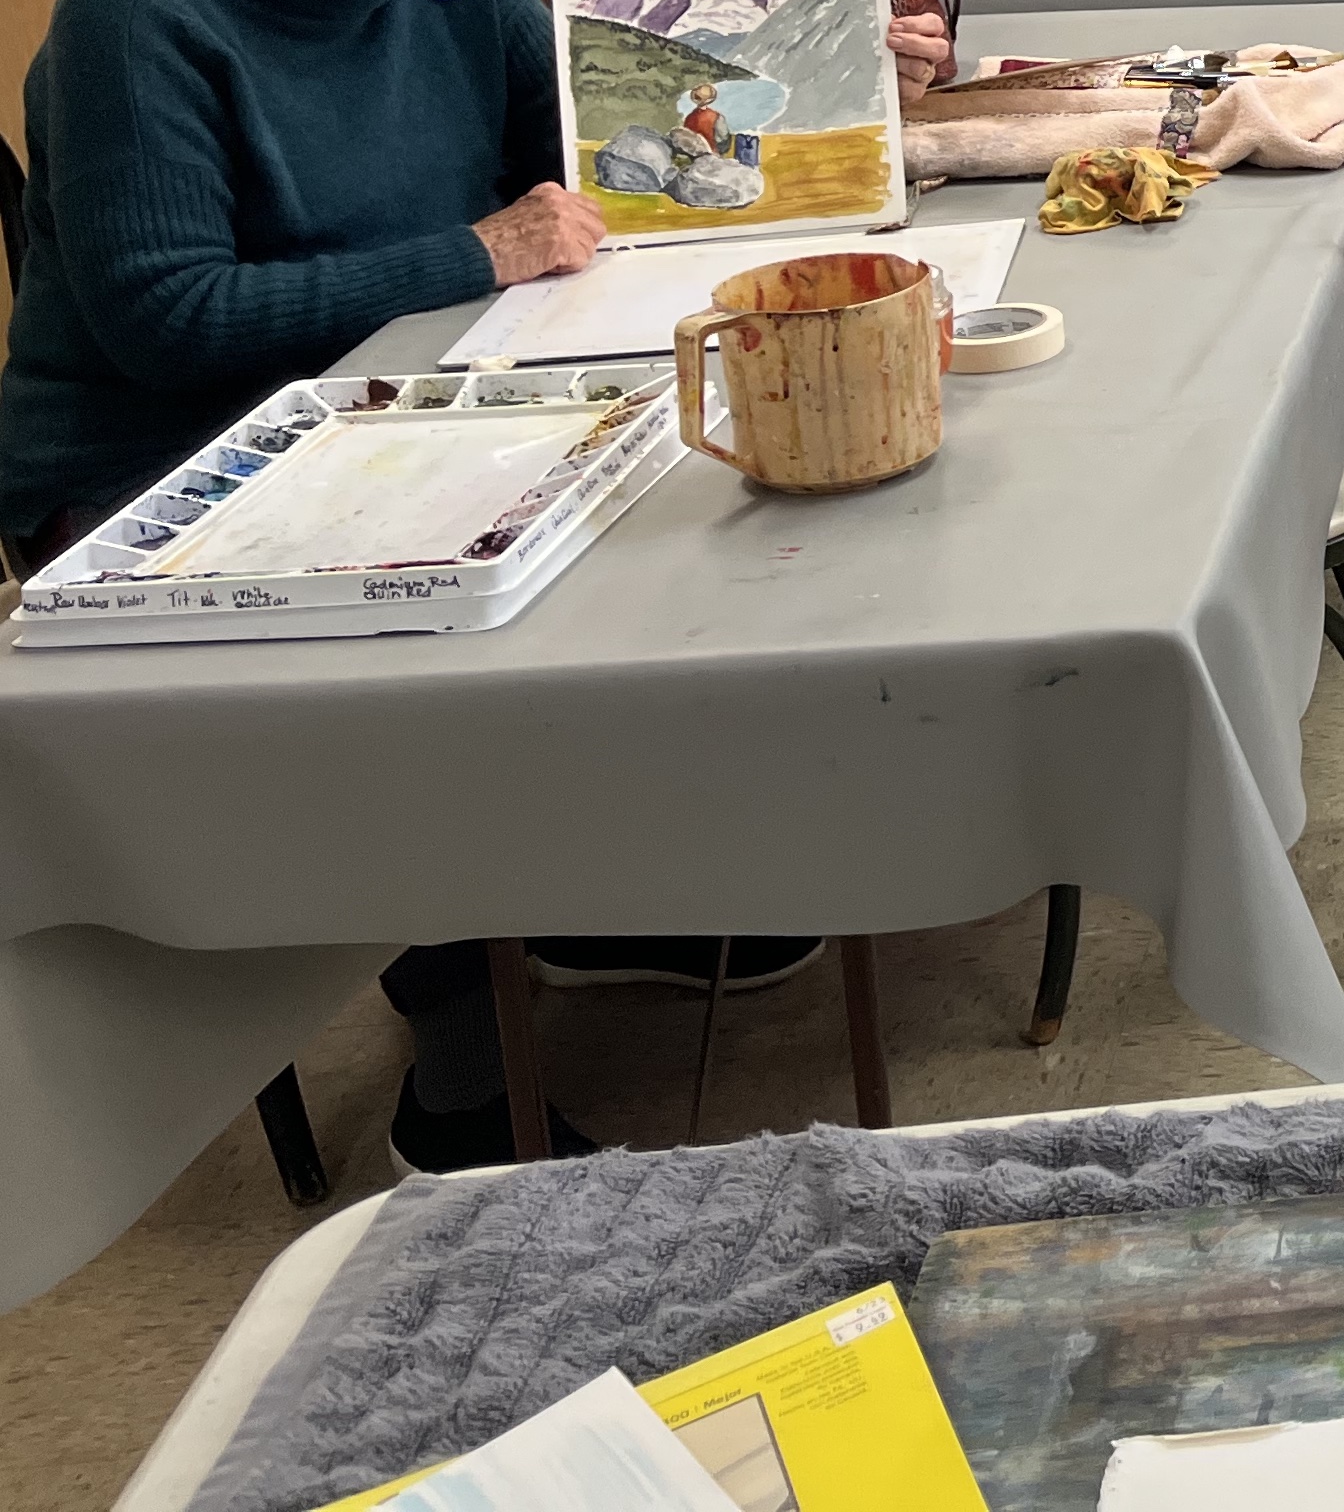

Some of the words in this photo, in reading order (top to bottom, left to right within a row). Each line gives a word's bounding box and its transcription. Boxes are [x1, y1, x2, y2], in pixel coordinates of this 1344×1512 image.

[363, 575, 426, 590] Cadmium
[429, 575, 461, 588] Red
[703, 1388, 742, 1410] Mejor
